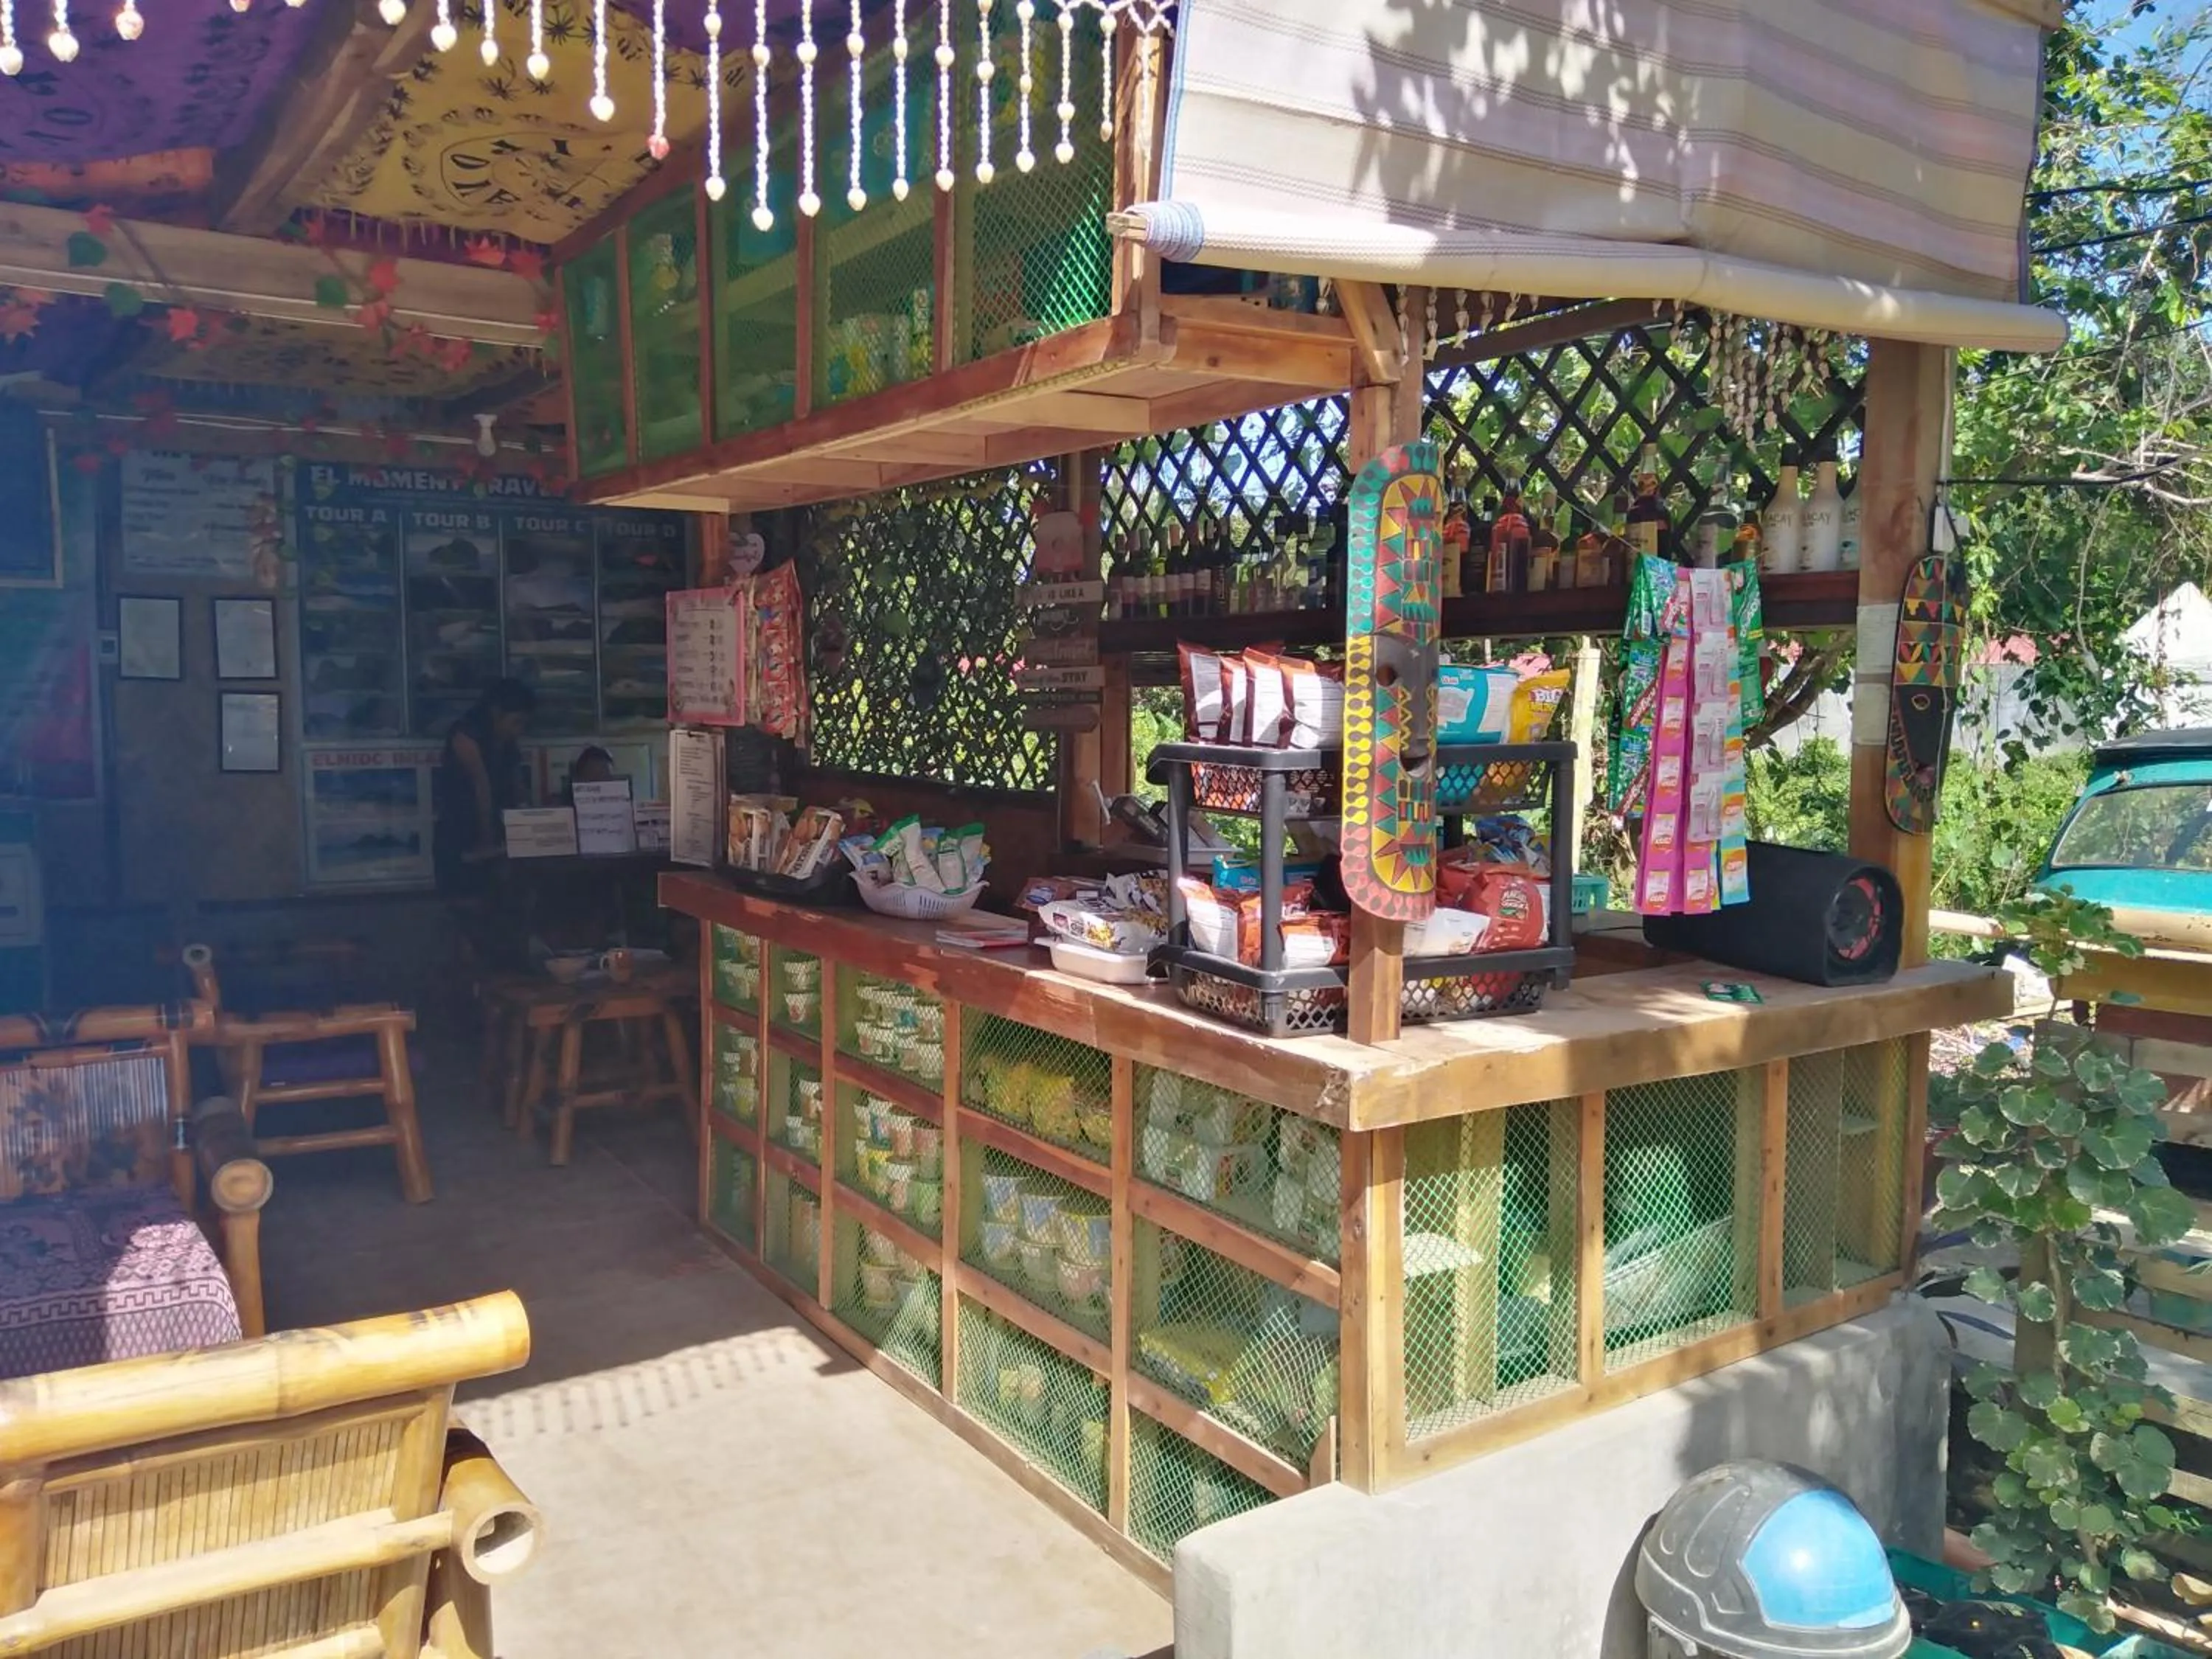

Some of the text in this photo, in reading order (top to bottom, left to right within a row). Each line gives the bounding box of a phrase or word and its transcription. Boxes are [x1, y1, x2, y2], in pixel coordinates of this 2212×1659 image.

[304, 506, 388, 522] TOUR A
[413, 512, 493, 529] TOUR B
[515, 517, 568, 532] TOUR
